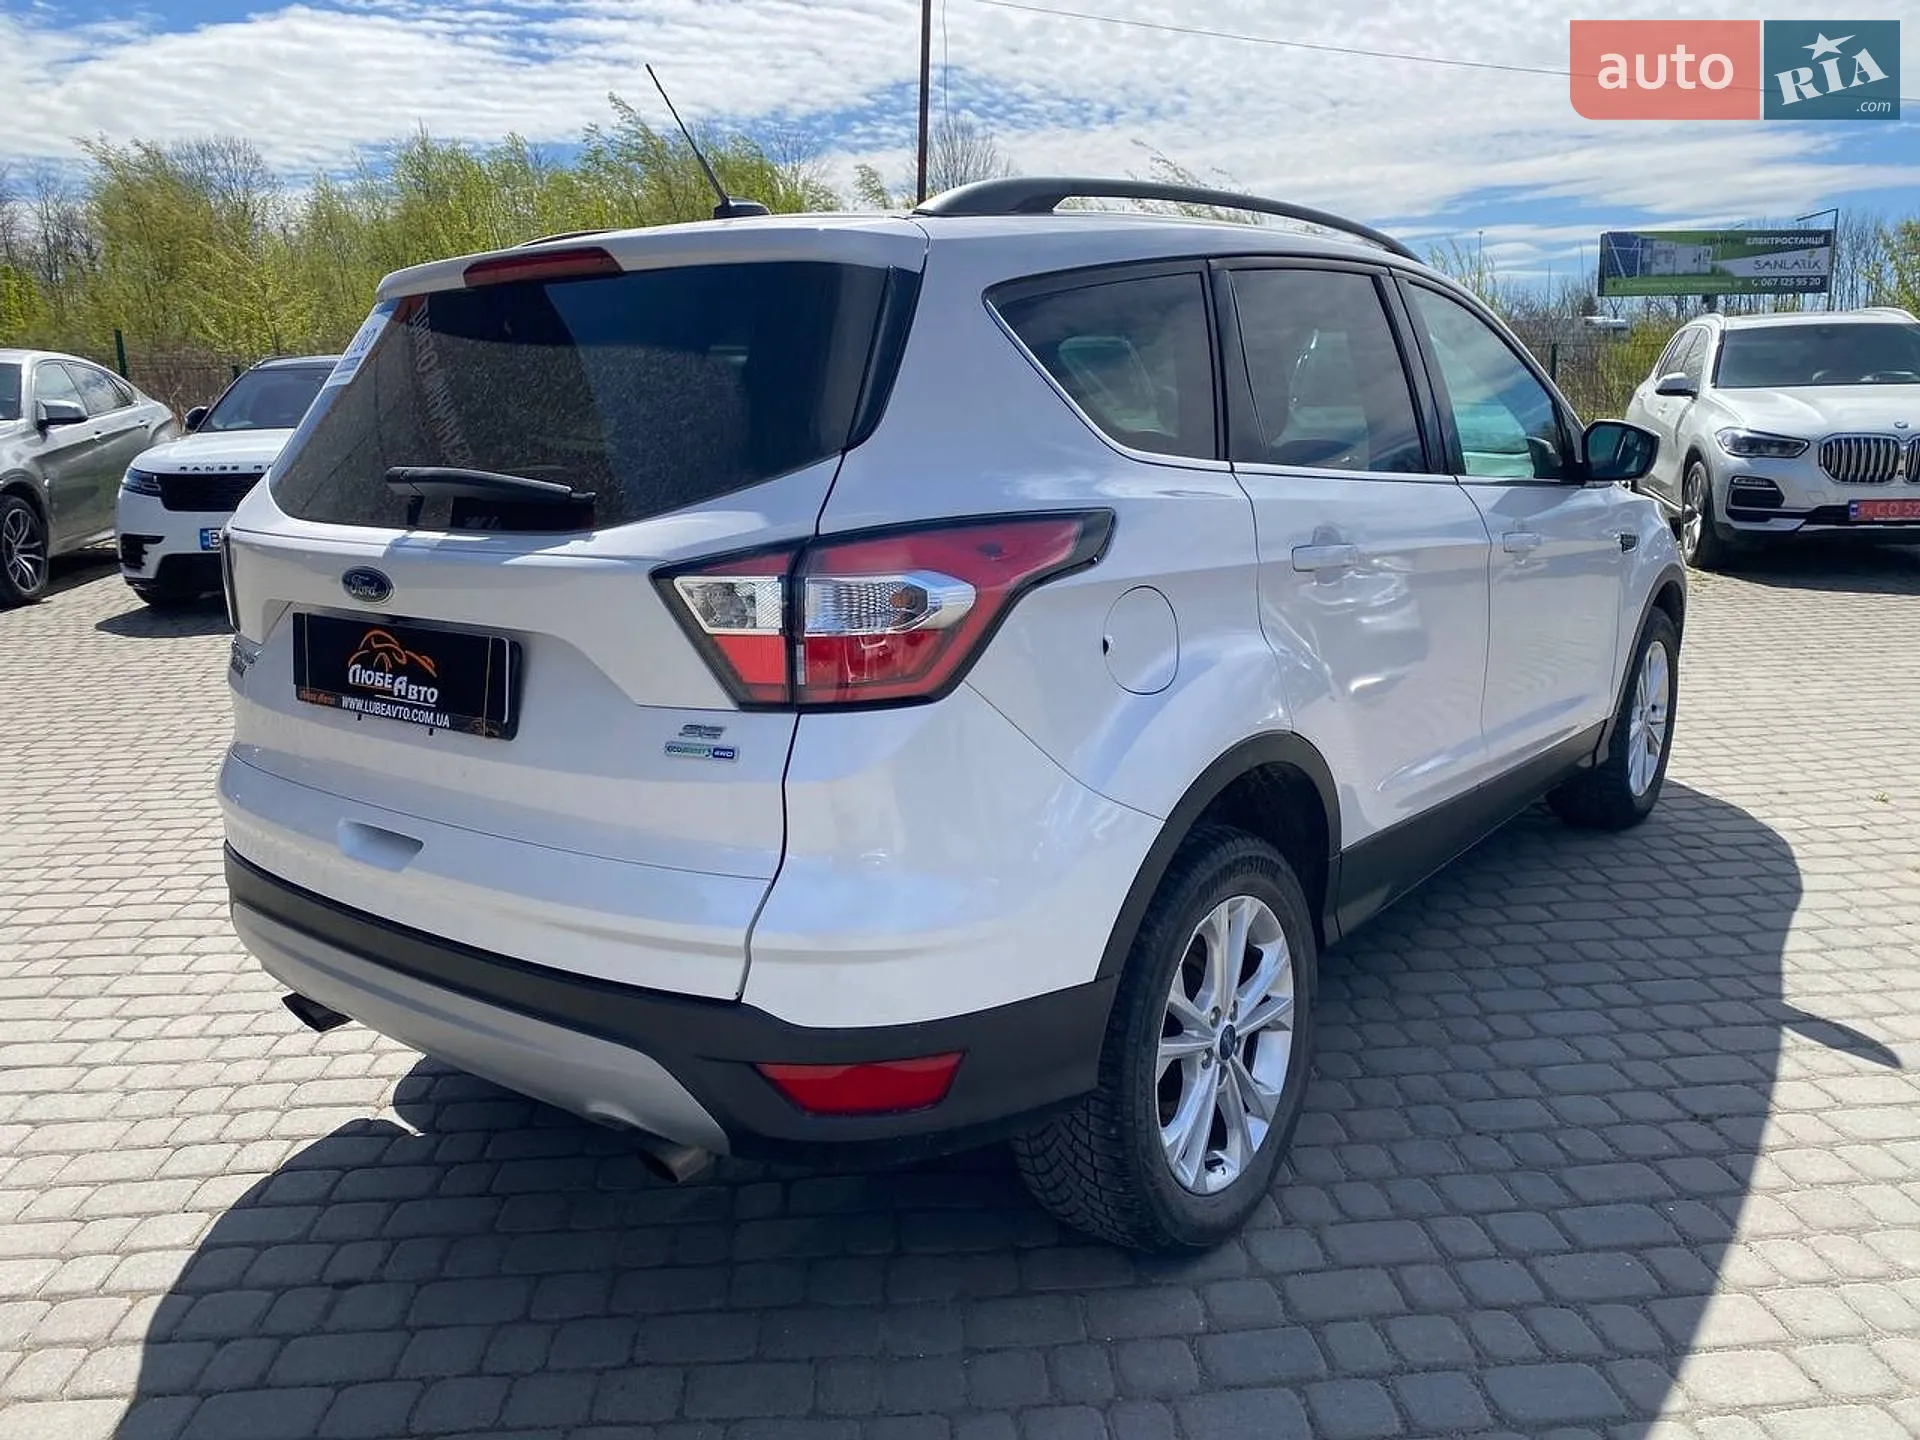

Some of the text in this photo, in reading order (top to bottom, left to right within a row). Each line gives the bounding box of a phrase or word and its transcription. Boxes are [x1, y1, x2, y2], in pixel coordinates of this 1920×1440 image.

[179, 464, 240, 472] RANGE
[351, 574, 378, 597] Ford
[341, 695, 450, 729] WWW.LUBEAVTO.COM.UA
